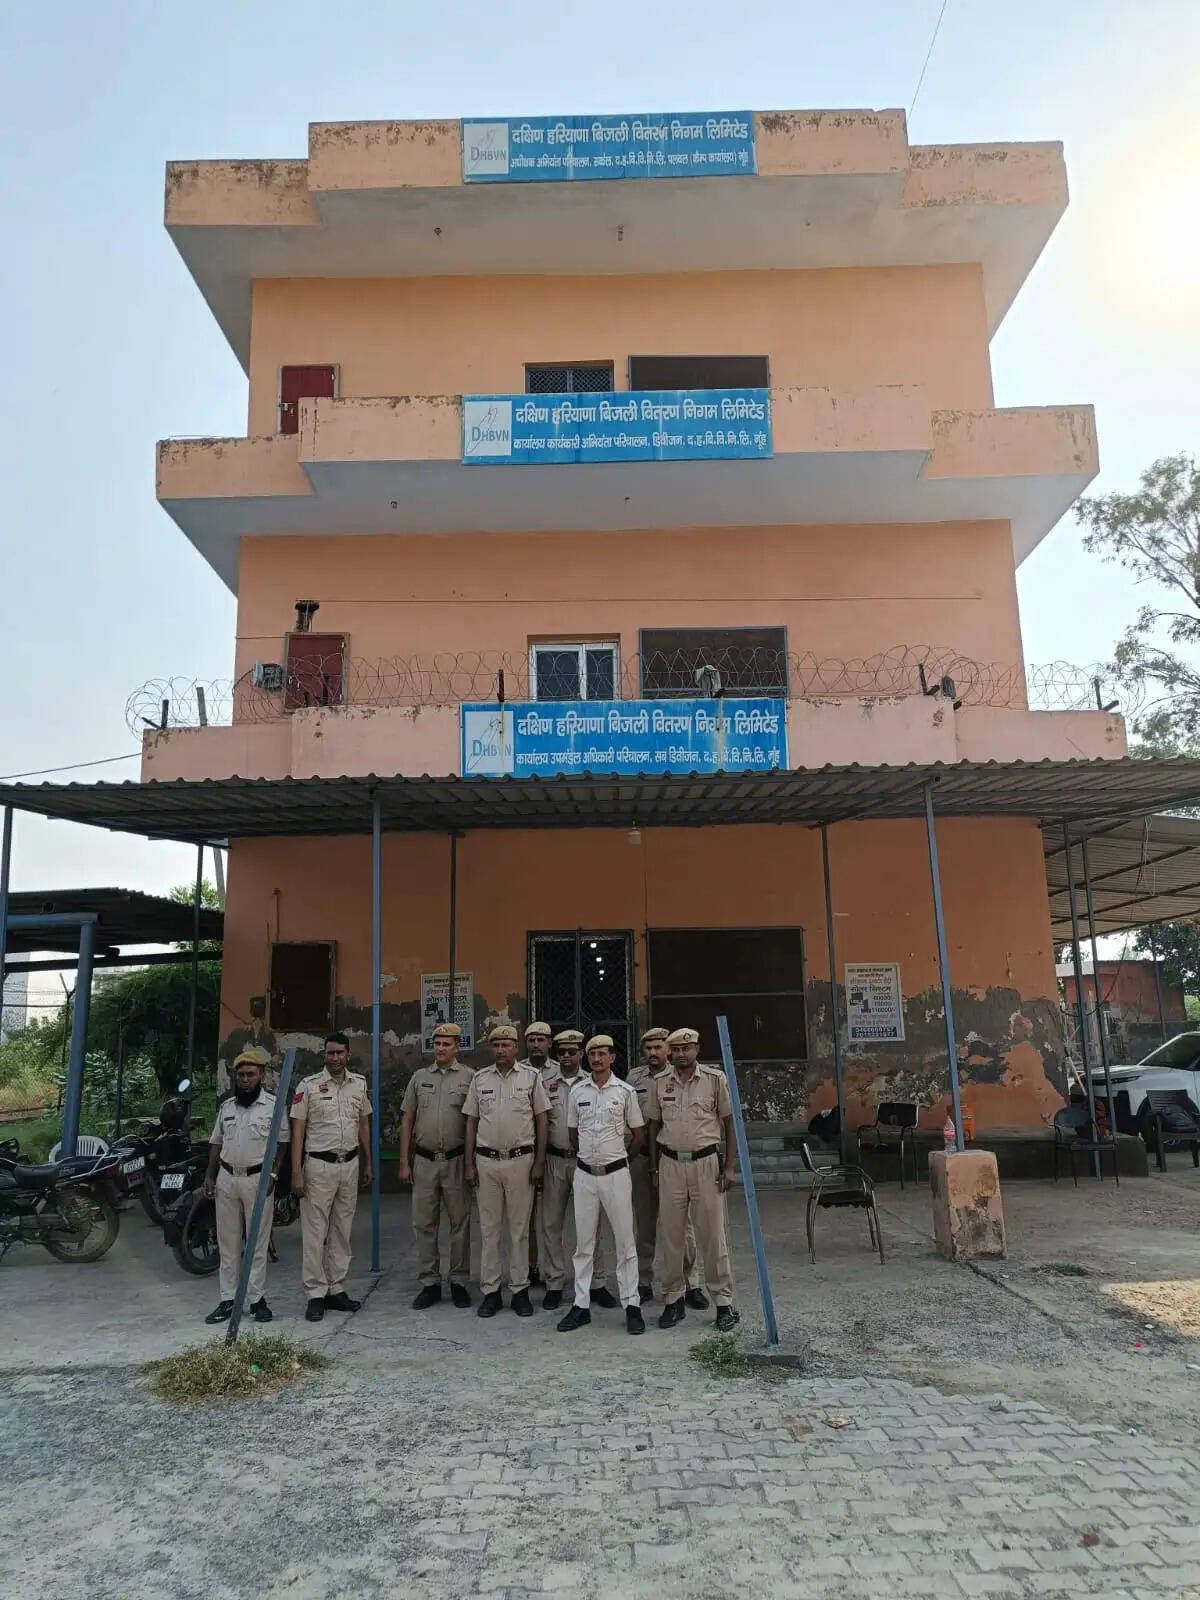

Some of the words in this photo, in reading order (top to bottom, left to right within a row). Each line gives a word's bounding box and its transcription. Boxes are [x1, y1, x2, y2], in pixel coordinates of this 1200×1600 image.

[511, 123, 544, 144] दक्षिण
[547, 122, 589, 144] हरियाणा
[591, 121, 629, 143] बिजली
[632, 120, 668, 141] वितरण
[671, 119, 704, 141] निगम
[706, 118, 748, 140] लिमिटेड
[470, 146, 507, 161] DHBVN
[515, 401, 549, 424] दक्षिण
[552, 401, 597, 425] हरियाणा
[599, 399, 638, 422] बिजली
[641, 399, 680, 421] वितरण
[684, 398, 718, 420] निगम
[721, 397, 765, 420] लिमिटेड
[471, 426, 509, 442] DHBVN
[513, 435, 546, 449] कार्यालय
[547, 434, 580, 449] कार्यकारी
[582, 433, 613, 449] अभियंता
[517, 711, 553, 736] दक्षिण
[556, 710, 605, 737] हरियाणा
[608, 709, 649, 734] बिजली
[652, 709, 692, 733] वितरण
[695, 709, 731, 734] निगम
[734, 709, 779, 735] लिमिटेड
[516, 749, 548, 765] कार्यालय
[550, 748, 581, 765] उपमंडल
[583, 747, 614, 763] अधिकारी
[654, 750, 667, 763] सब
